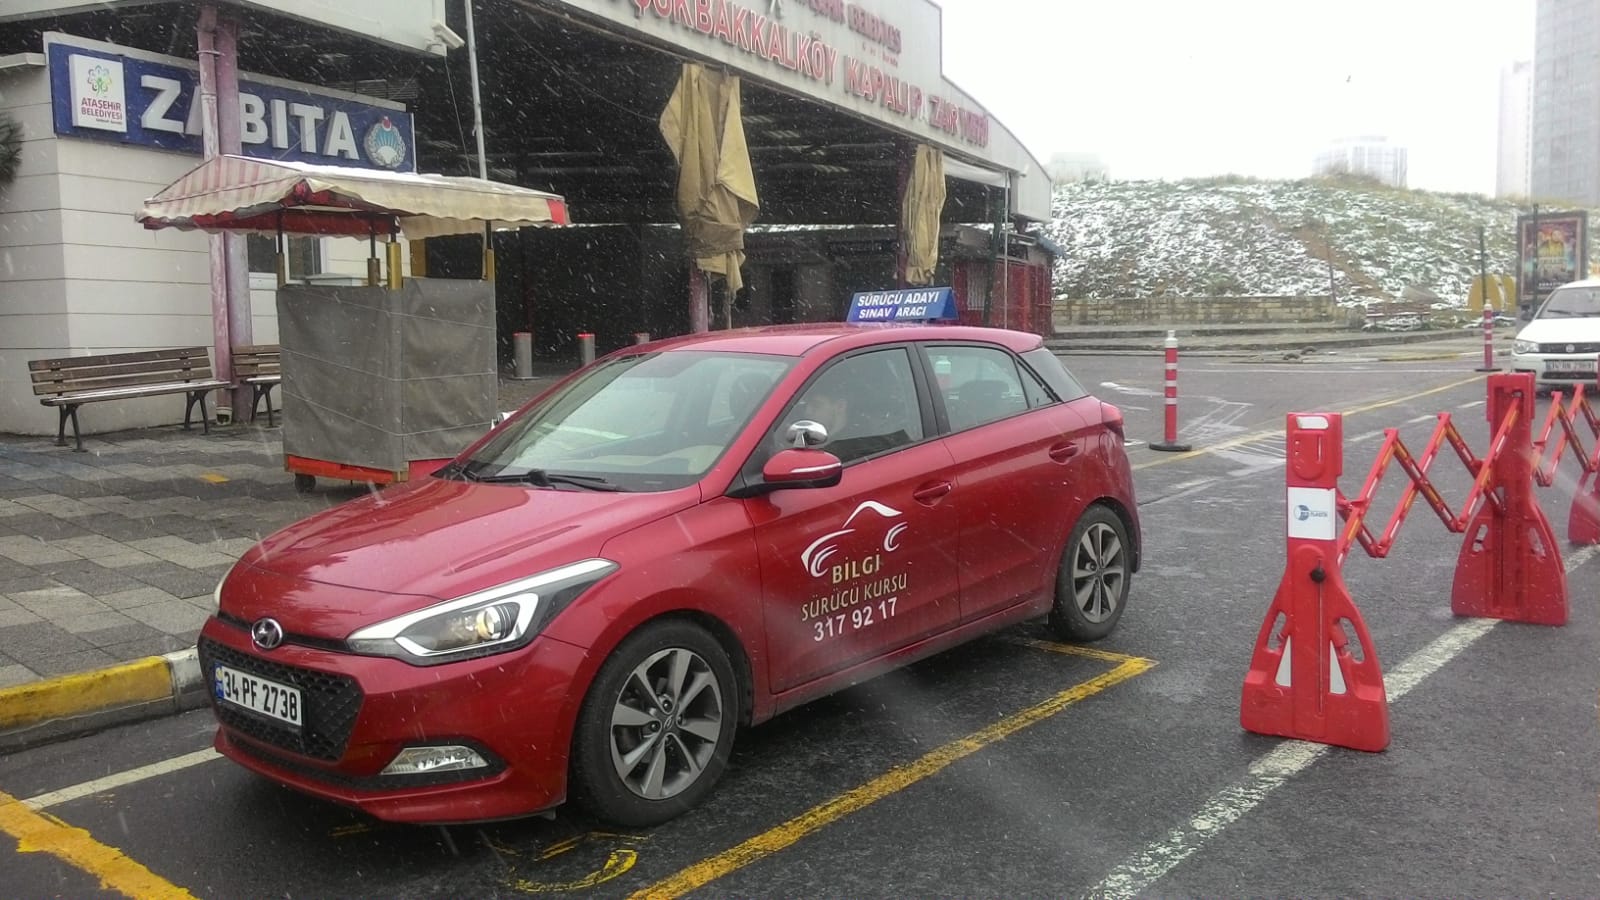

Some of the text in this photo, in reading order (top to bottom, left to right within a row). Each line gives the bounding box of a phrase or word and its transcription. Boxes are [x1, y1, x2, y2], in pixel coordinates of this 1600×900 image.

[844, 55, 910, 117] KAPALI
[858, 306, 928, 319] SINAV ARACI
[904, 291, 940, 304] ADAYI
[832, 548, 881, 584] BİLGİ
[801, 573, 907, 622] SÜRÜCÜ KURSU
[813, 597, 898, 642] 317 92 17
[223, 671, 298, 721] 34 PF 2738
